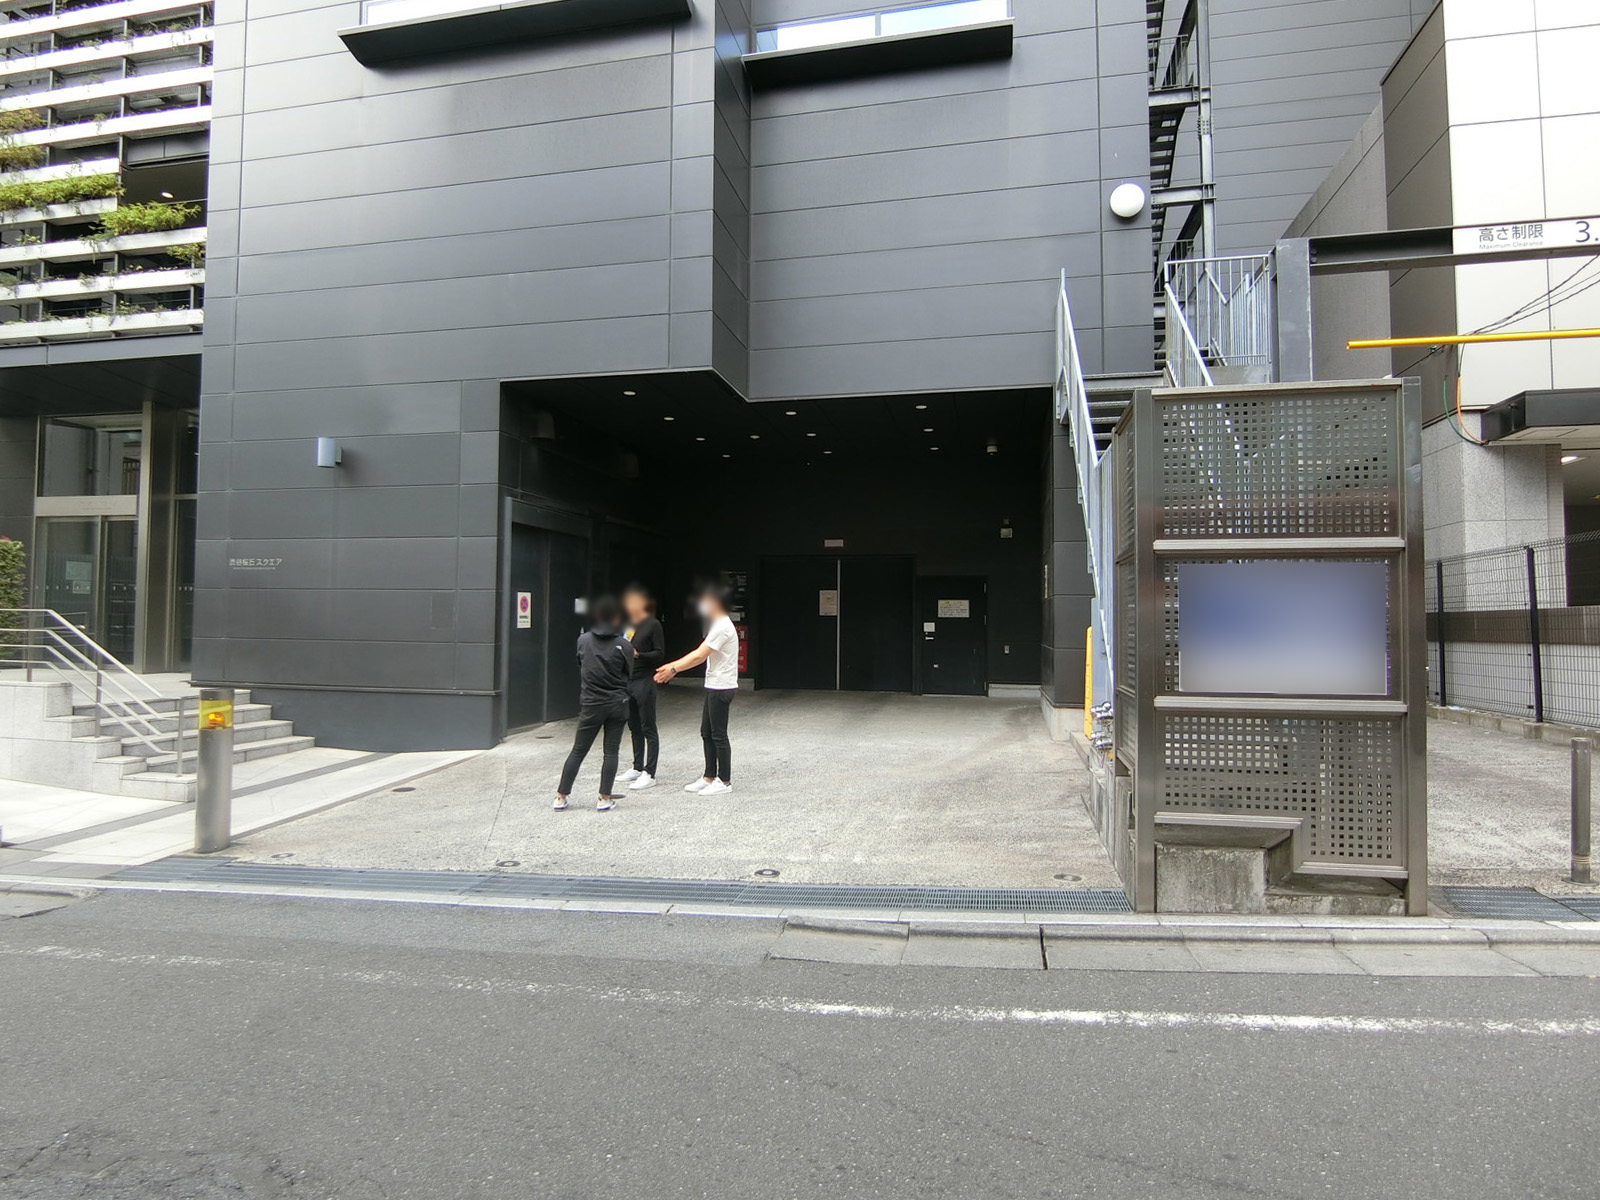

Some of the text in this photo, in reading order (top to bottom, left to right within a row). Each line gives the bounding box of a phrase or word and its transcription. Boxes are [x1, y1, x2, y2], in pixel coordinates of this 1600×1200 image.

[1479, 223, 1544, 243] 高さ制限
[1512, 240, 1543, 248] Clearance
